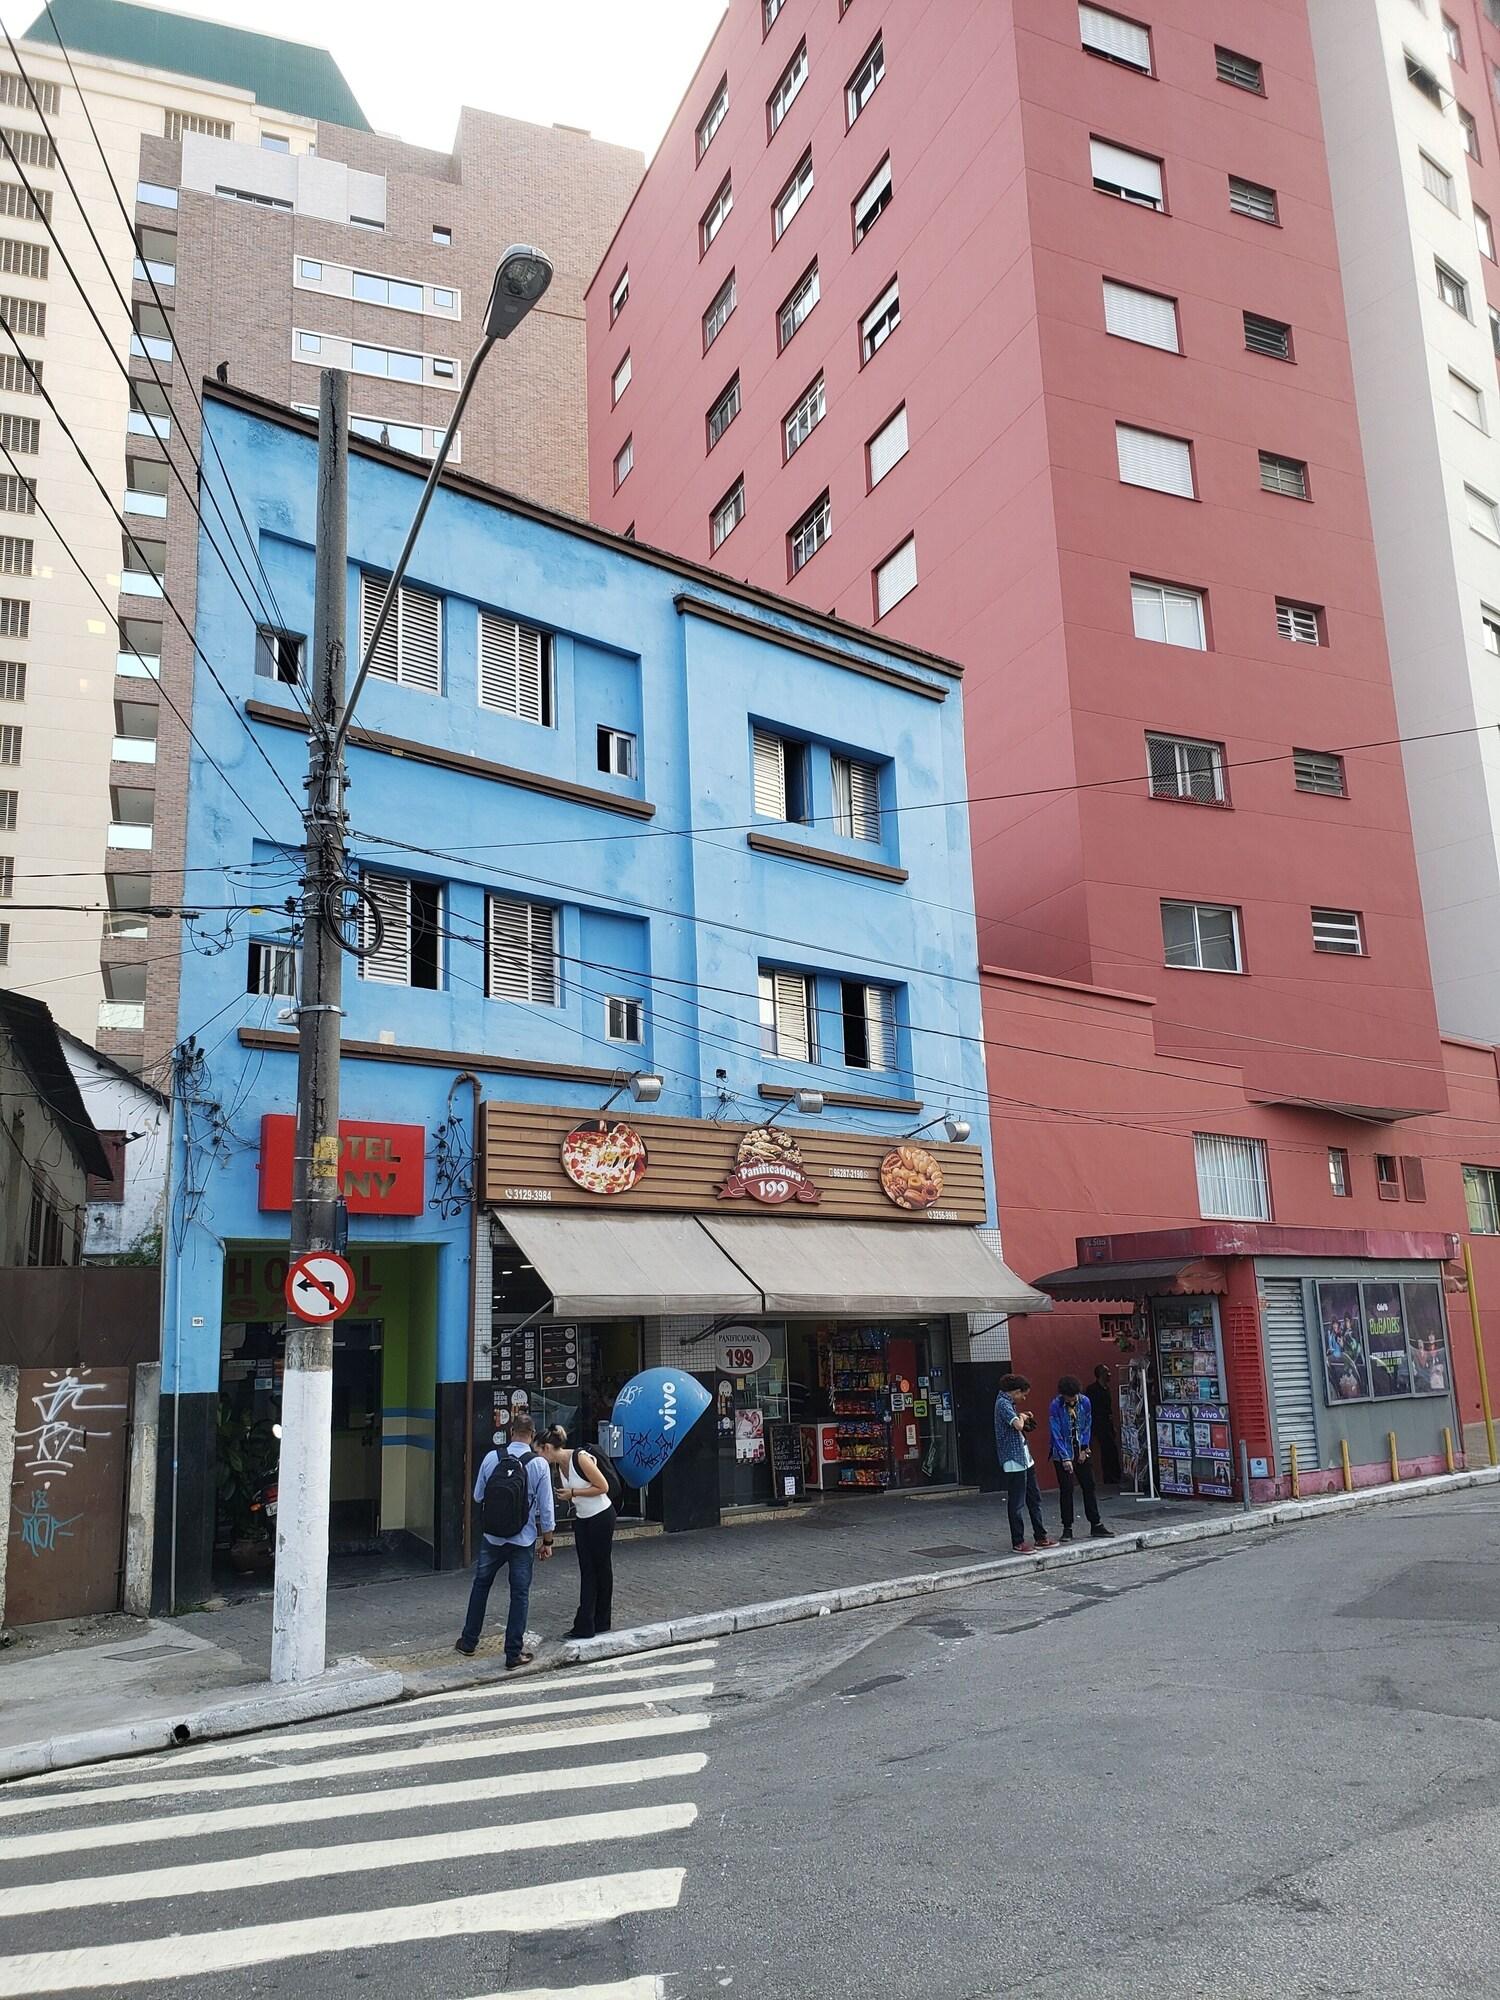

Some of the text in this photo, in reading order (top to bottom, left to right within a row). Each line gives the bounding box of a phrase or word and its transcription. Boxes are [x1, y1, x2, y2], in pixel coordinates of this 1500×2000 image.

[337, 1135, 401, 1164] TEL
[740, 1163, 801, 1180] Panificadora
[337, 1169, 396, 1199] NY
[758, 1181, 789, 1197] 199
[513, 1188, 552, 1200] 3129-3984
[228, 1256, 383, 1295] HOL
[718, 1334, 760, 1343] PANIFICADORA
[726, 1348, 753, 1367] 199
[658, 1382, 677, 1431] vivo
[1164, 1409, 1181, 1419] vivo
[1200, 1409, 1218, 1419] vivo
